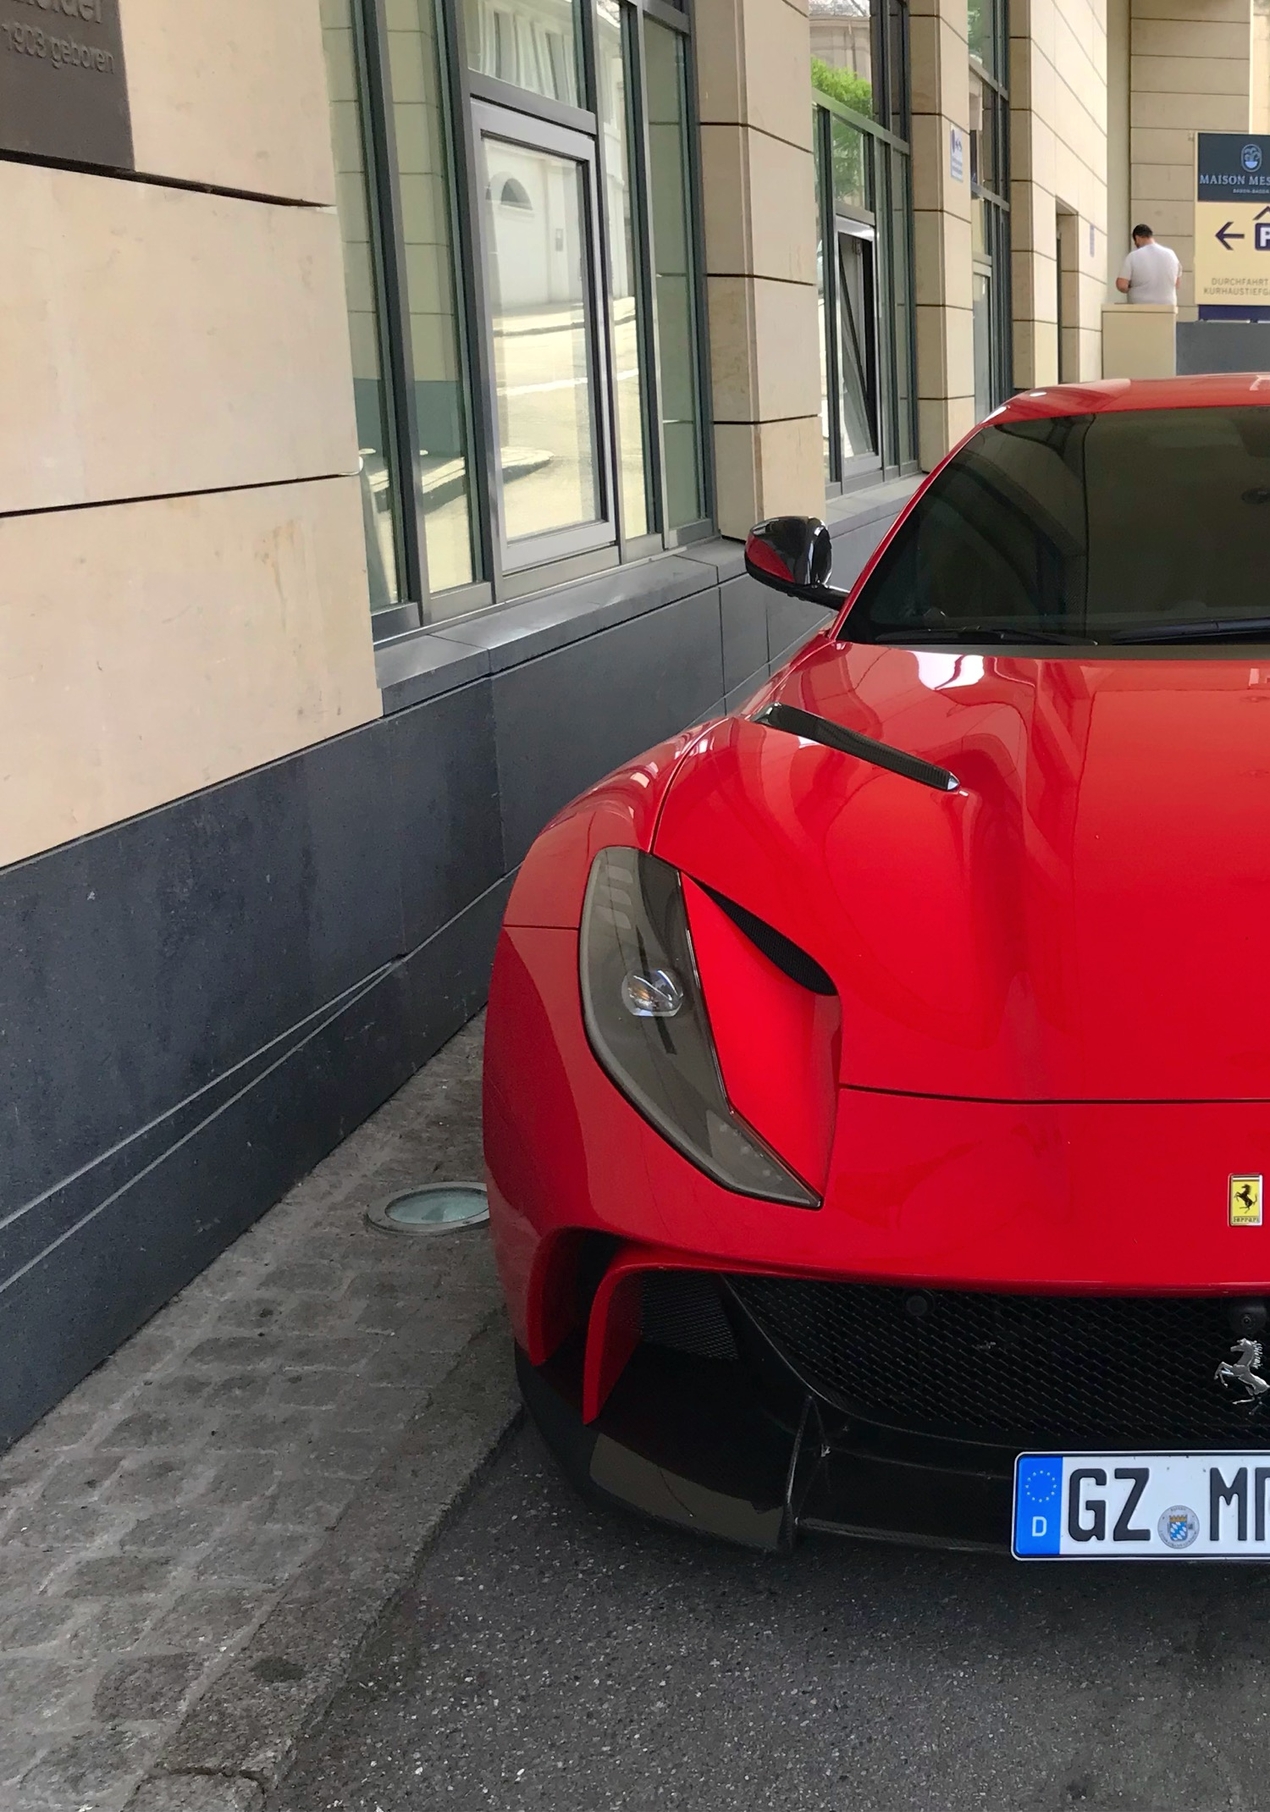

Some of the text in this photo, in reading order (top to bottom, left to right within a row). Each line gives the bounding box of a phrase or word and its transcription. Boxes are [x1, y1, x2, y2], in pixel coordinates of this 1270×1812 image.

[1199, 174, 1245, 185] MAISON
[1211, 277, 1269, 286] DURCHFAHRT
[1067, 1467, 1151, 1542] GZ
[1031, 1517, 1048, 1537] D
